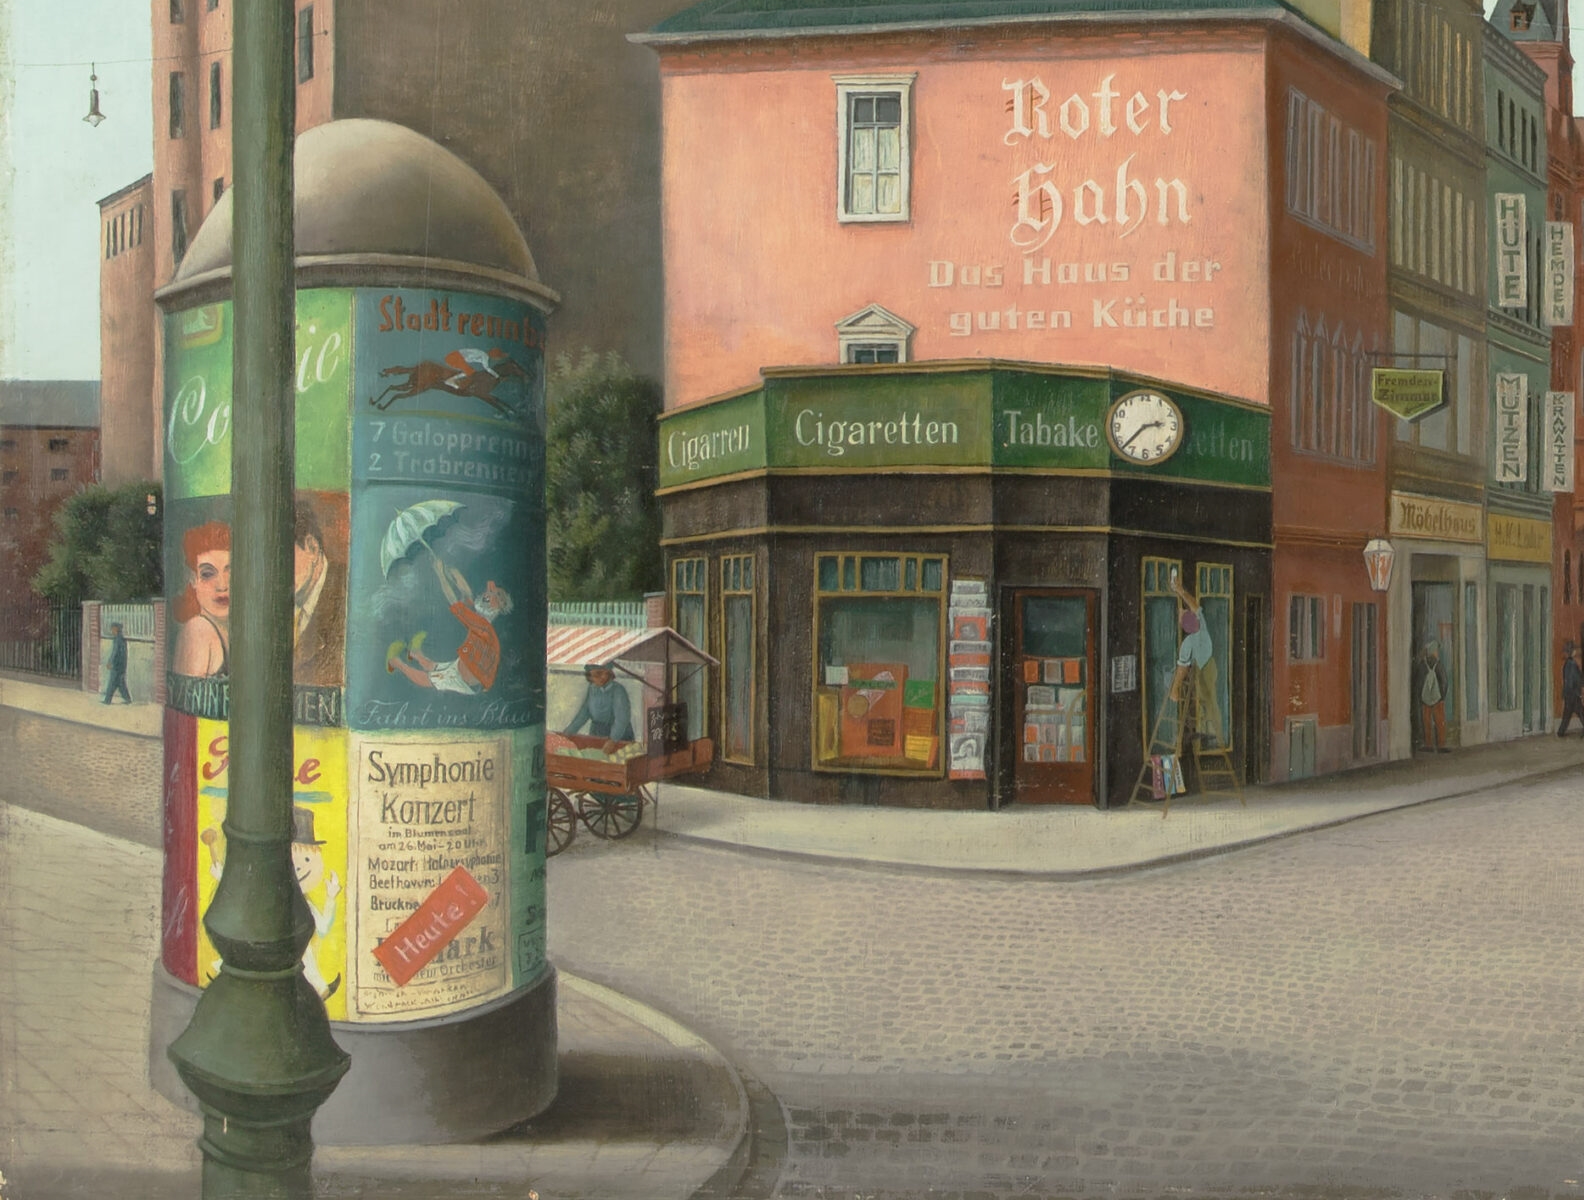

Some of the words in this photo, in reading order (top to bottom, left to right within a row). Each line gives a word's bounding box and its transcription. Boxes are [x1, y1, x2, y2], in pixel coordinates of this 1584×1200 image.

[1001, 73, 1188, 146] Roter
[1009, 152, 1192, 254] Hahn
[1500, 199, 1521, 300] HÜTE
[927, 259, 1003, 287] Das
[1023, 257, 1131, 286] Haus
[1153, 251, 1222, 283] der
[1550, 225, 1566, 319] HEMDEN
[949, 301, 1072, 337] guten
[1092, 296, 1216, 329] Küche
[369, 421, 386, 443] 7
[668, 423, 750, 470] Cigarren
[795, 408, 958, 456] Cigaretten
[1003, 410, 1099, 448] Tabake
[1552, 394, 1567, 486] KRAWATTEN
[368, 452, 383, 472] 2
[1400, 501, 1476, 537] Möbelhaus
[358, 699, 434, 726] Fahrt
[436, 704, 469, 725] ins
[367, 750, 495, 789] Symphonie
[380, 790, 477, 825] Konzert
[378, 843, 396, 851] am
[388, 826, 402, 838] im
[370, 895, 420, 911] Brückne
